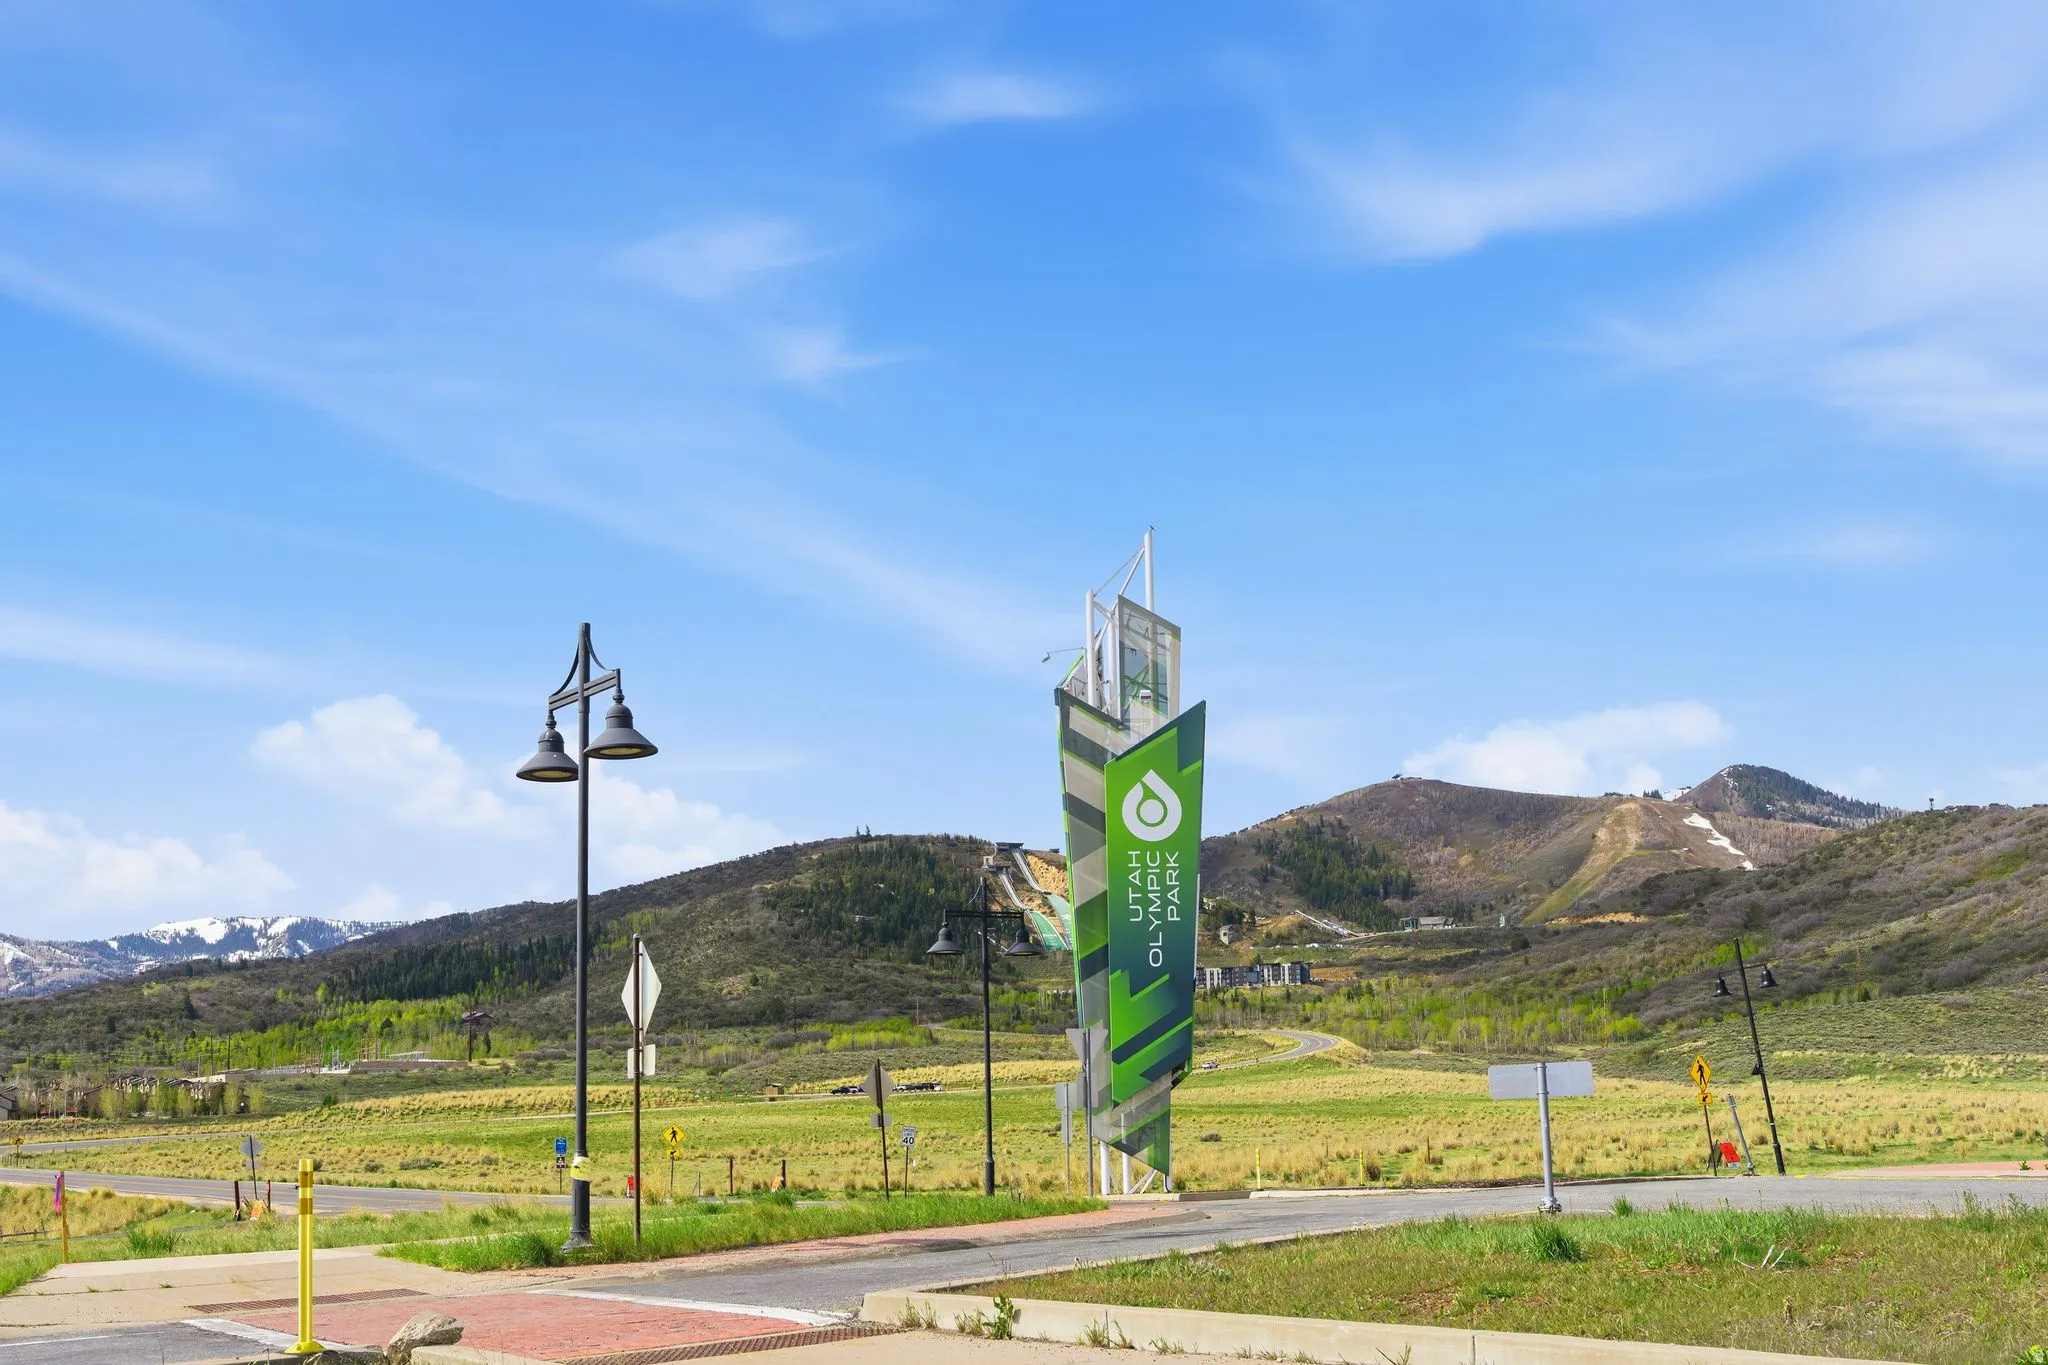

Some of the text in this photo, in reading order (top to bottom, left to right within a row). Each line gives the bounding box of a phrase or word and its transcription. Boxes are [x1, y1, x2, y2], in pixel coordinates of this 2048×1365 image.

[1128, 851, 1143, 922] UTAH
[1147, 850, 1163, 967] OLYMPIC
[1166, 851, 1181, 921] PARK
[903, 1136, 914, 1145] 40
